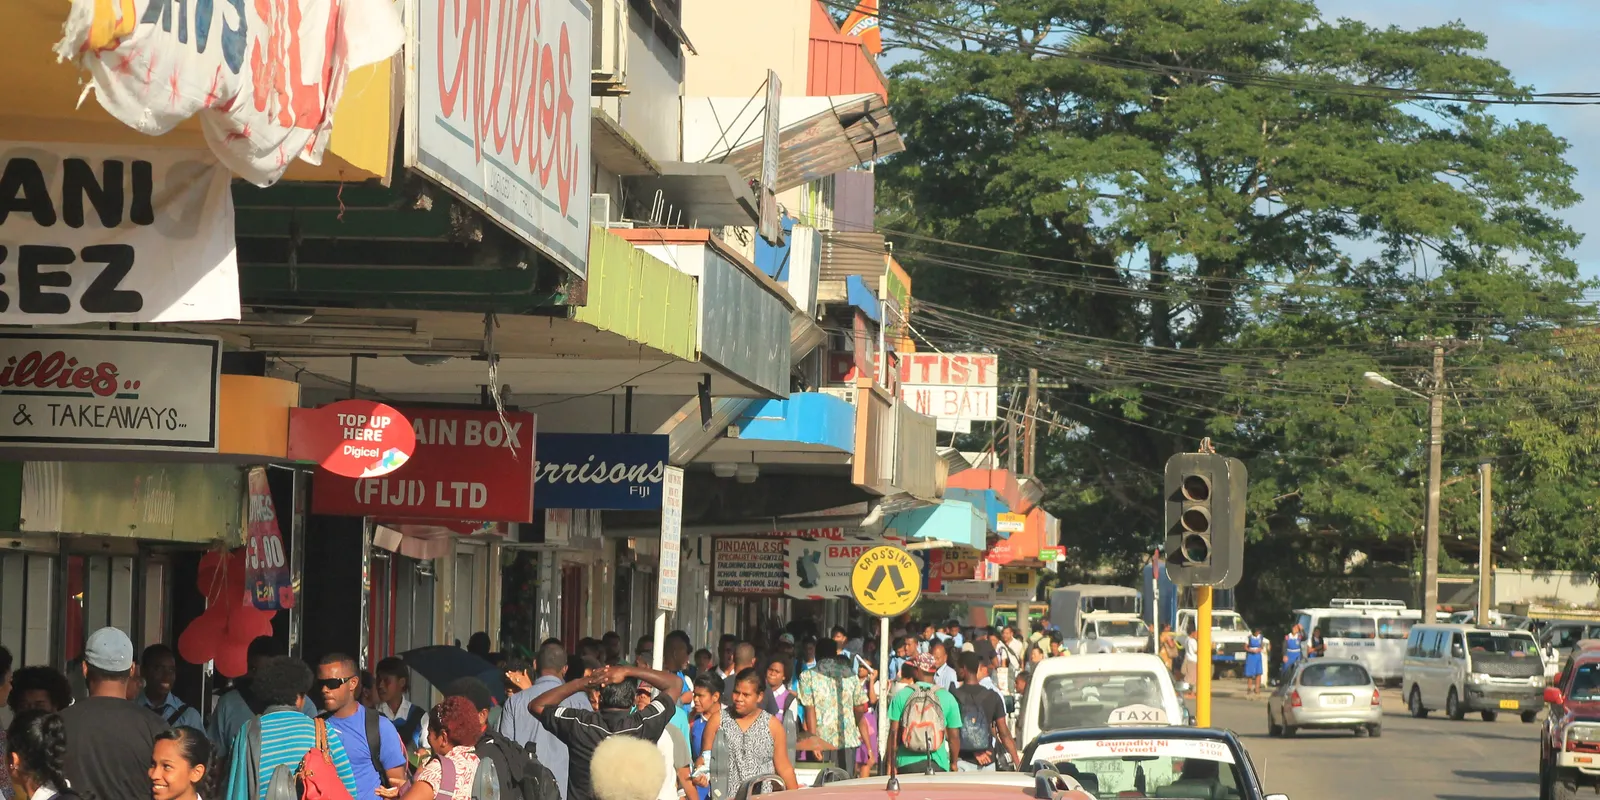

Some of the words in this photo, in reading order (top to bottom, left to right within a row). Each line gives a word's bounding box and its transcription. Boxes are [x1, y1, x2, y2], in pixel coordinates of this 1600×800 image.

[0, 243, 144, 314] EZ
[944, 390, 989, 417] BATI
[13, 403, 34, 426] &
[337, 413, 367, 427] TOP
[370, 415, 391, 429] UP
[343, 428, 383, 442] HERE
[464, 420, 523, 449] BOX
[343, 446, 380, 459] Digicel
[354, 478, 426, 507] (FIJI)
[435, 481, 488, 509] LTD
[629, 485, 651, 498] FIJI
[716, 540, 760, 553] DINDAYAL
[762, 541, 770, 552] &
[859, 550, 912, 571] CROSSING
[825, 585, 842, 593] Vale
[1115, 710, 1159, 721] TAXI
[1096, 740, 1154, 748] Gaunadivi
